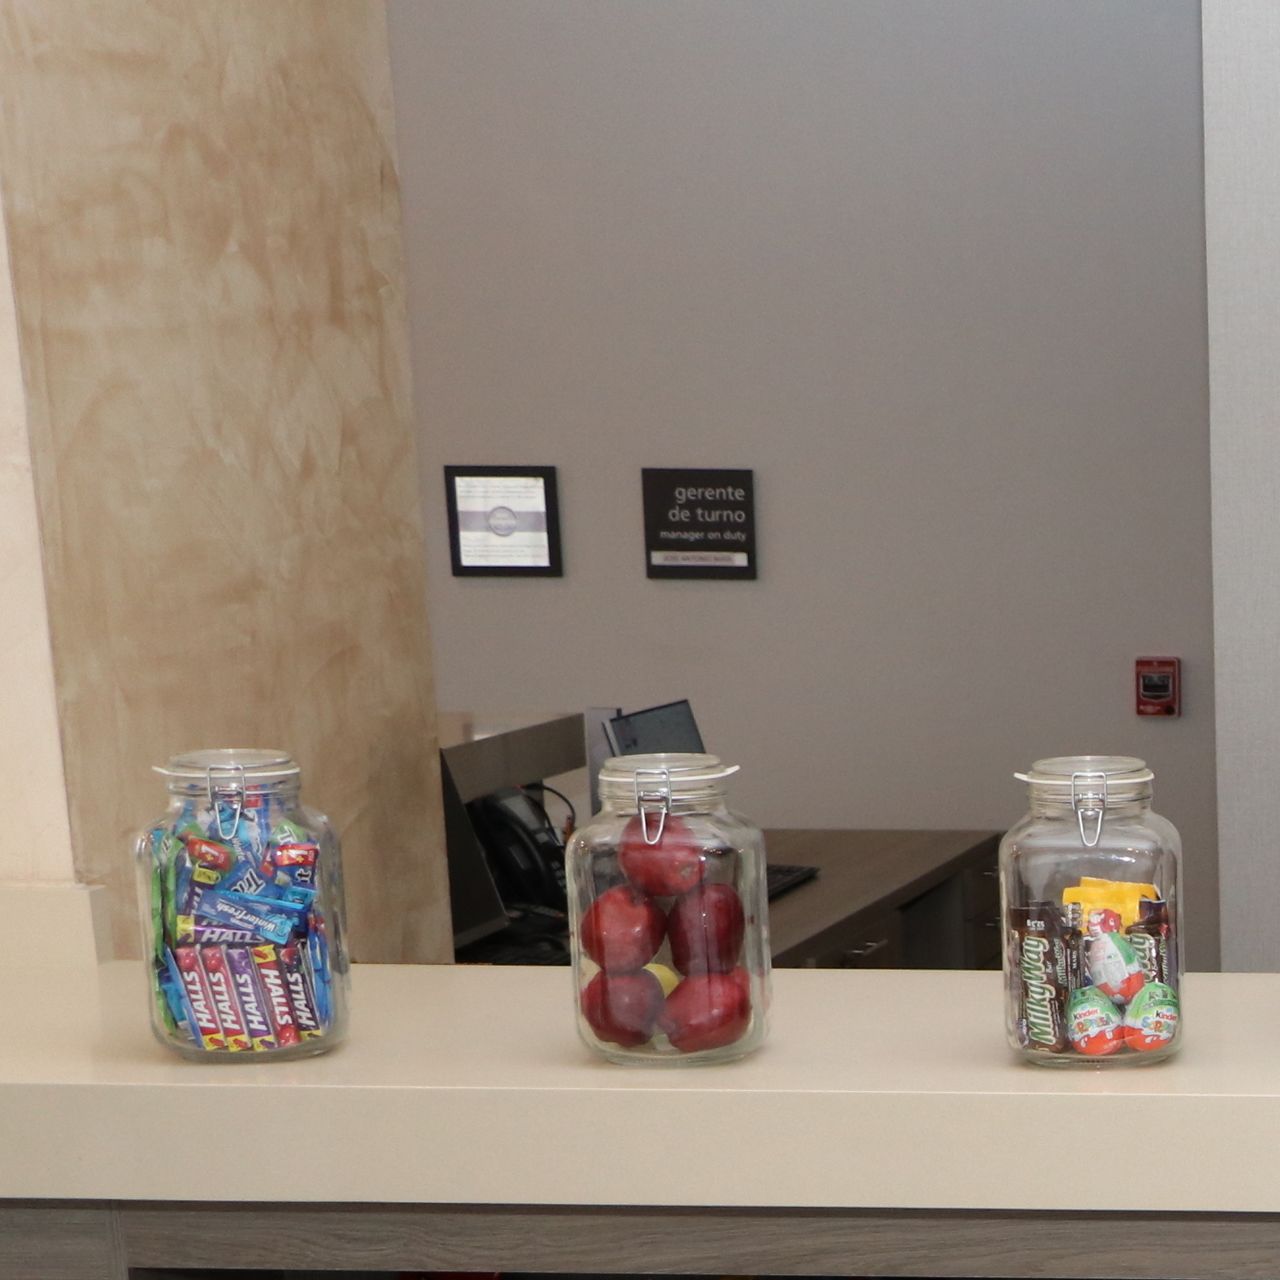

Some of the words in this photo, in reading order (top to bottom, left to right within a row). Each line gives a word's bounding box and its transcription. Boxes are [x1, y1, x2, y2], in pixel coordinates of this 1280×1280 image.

[668, 506, 690, 522] de
[696, 507, 746, 522] turno
[675, 486, 745, 504] gerente
[660, 531, 705, 541] manager
[707, 532, 721, 540] on
[723, 530, 747, 542] duty
[216, 898, 278, 932] Winterfresh
[183, 970, 216, 1028] HALLS
[209, 972, 241, 1030] HALLS
[236, 973, 268, 1031] HALLS
[260, 968, 293, 1026] HALLS
[286, 972, 316, 1027] HALLS
